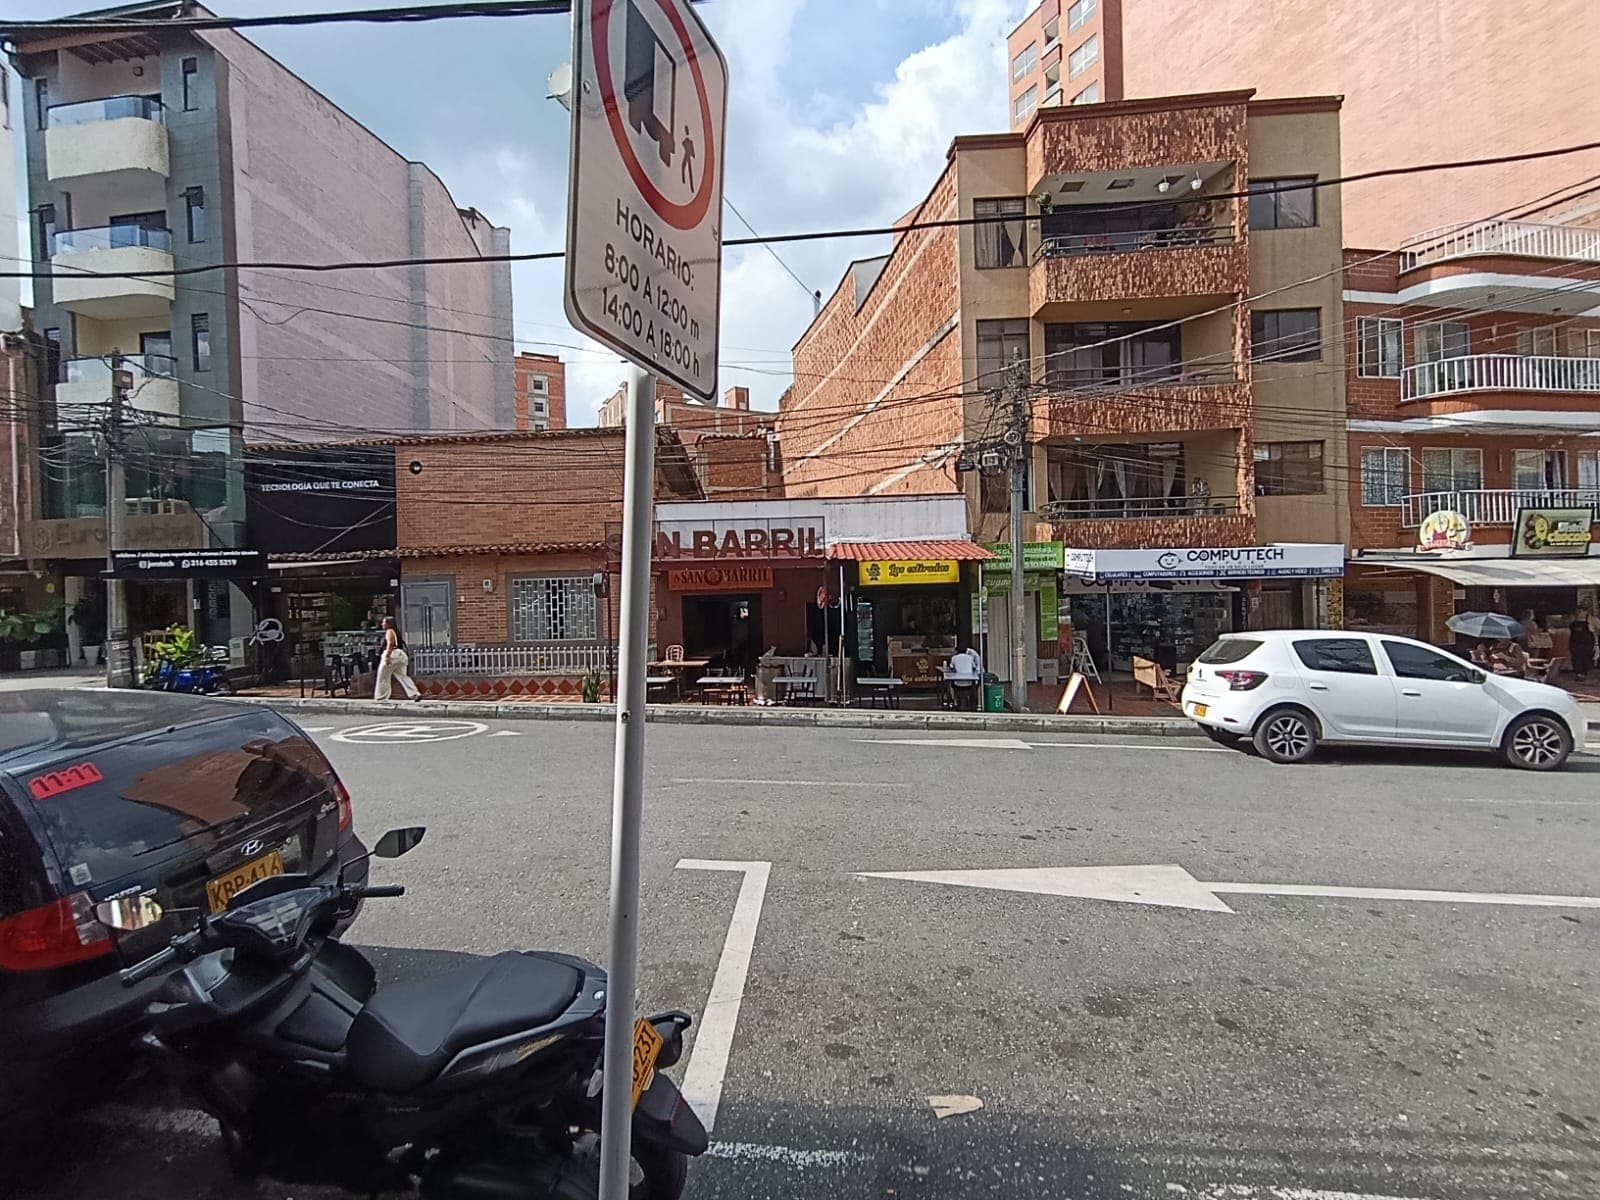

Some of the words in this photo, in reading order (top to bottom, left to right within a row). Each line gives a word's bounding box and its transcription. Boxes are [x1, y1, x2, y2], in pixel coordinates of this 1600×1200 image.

[616, 198, 695, 292] HORARIO:
[604, 243, 640, 292] 8:00
[642, 275, 653, 305] A
[657, 286, 688, 330] 12:00
[690, 317, 700, 341] m
[602, 286, 643, 338] 14:00
[645, 320, 656, 348] A
[660, 328, 691, 370] 18:00
[693, 351, 700, 378] h
[313, 481, 330, 490] QUE
[330, 481, 341, 490] TE
[342, 480, 380, 489] CONECTA
[693, 527, 823, 559] BARRIL
[1186, 548, 1284, 561] COMPUTECH
[32, 764, 99, 792] 11:11
